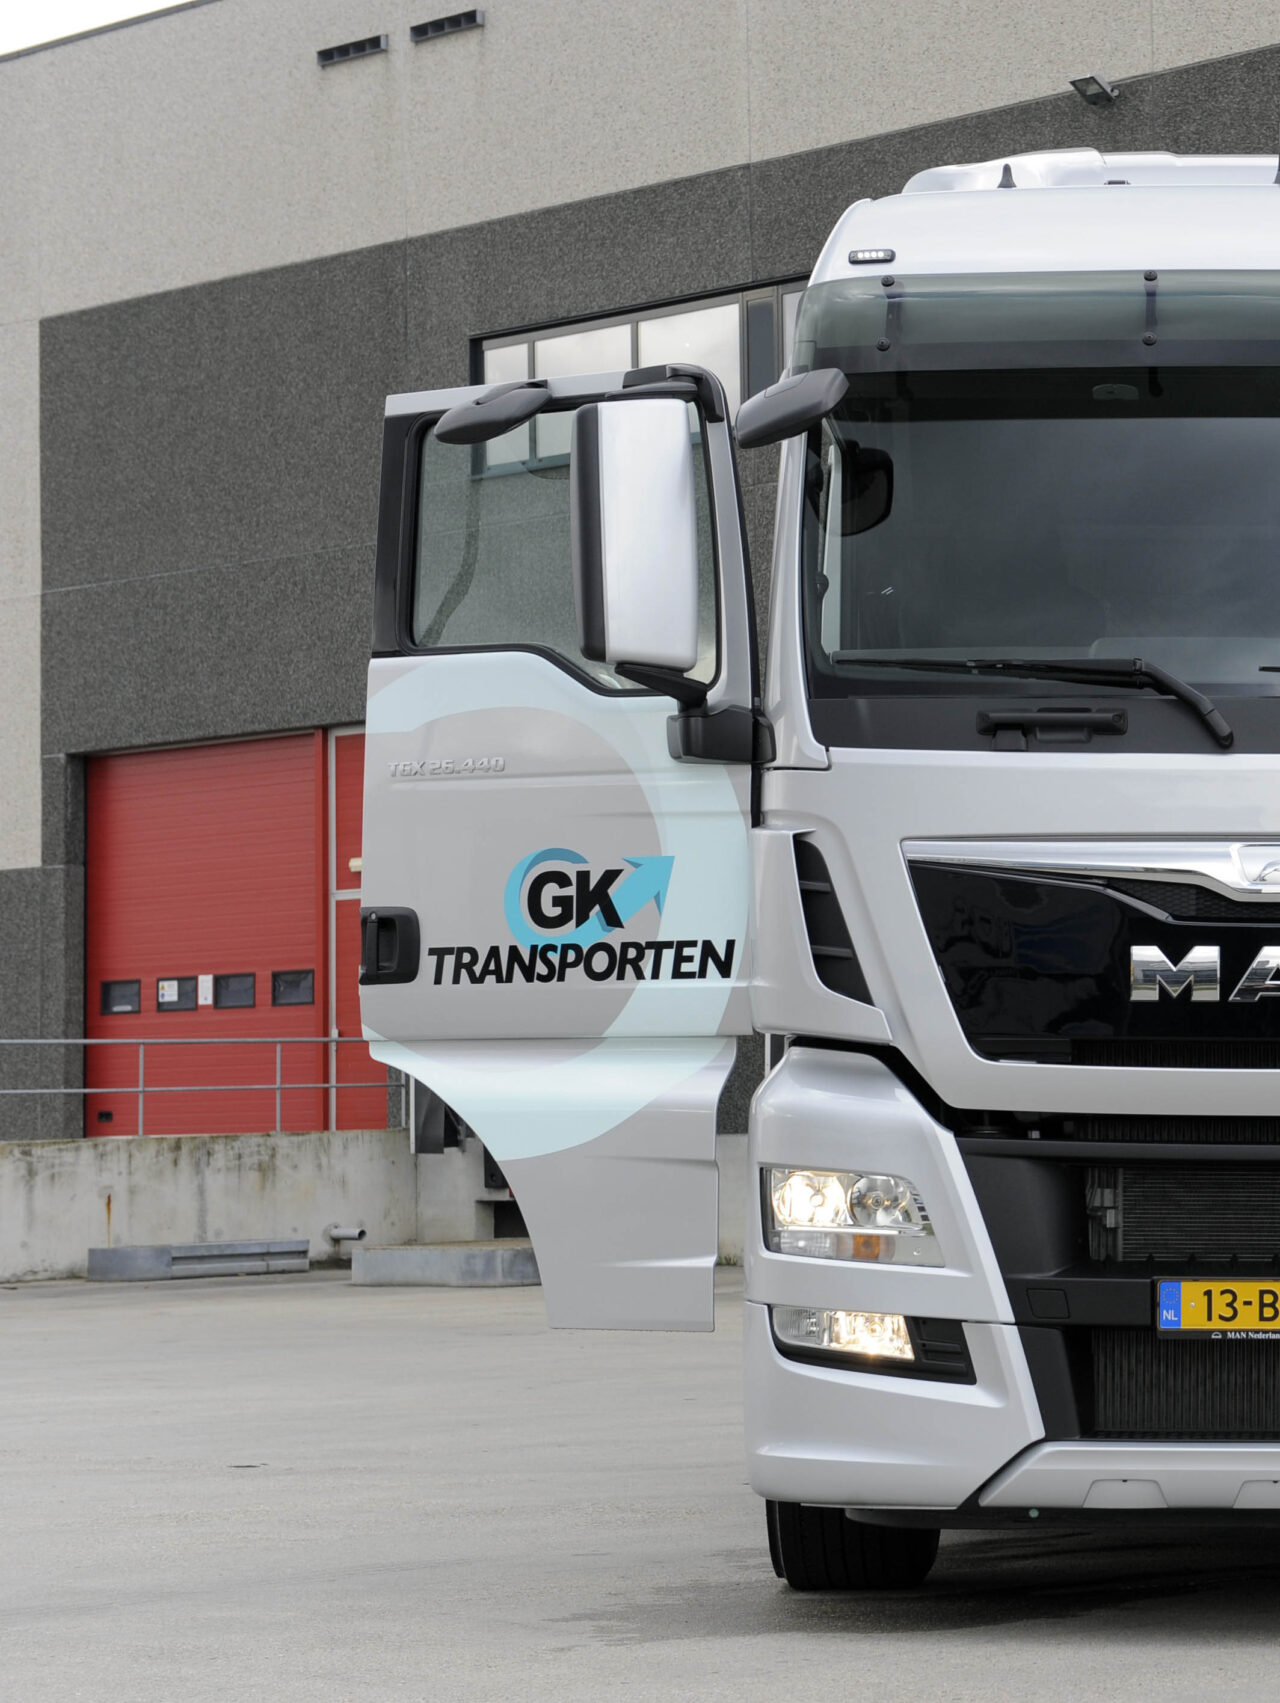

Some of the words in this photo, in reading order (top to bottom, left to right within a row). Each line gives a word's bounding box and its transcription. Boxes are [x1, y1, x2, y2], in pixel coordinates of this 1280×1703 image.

[388, 760, 426, 777] TGX
[429, 757, 505, 776] 26.440
[527, 868, 625, 930] GK
[428, 939, 736, 985] TRANSPORTEN
[1163, 1310, 1178, 1321] NL
[1227, 1331, 1247, 1340] MAN
